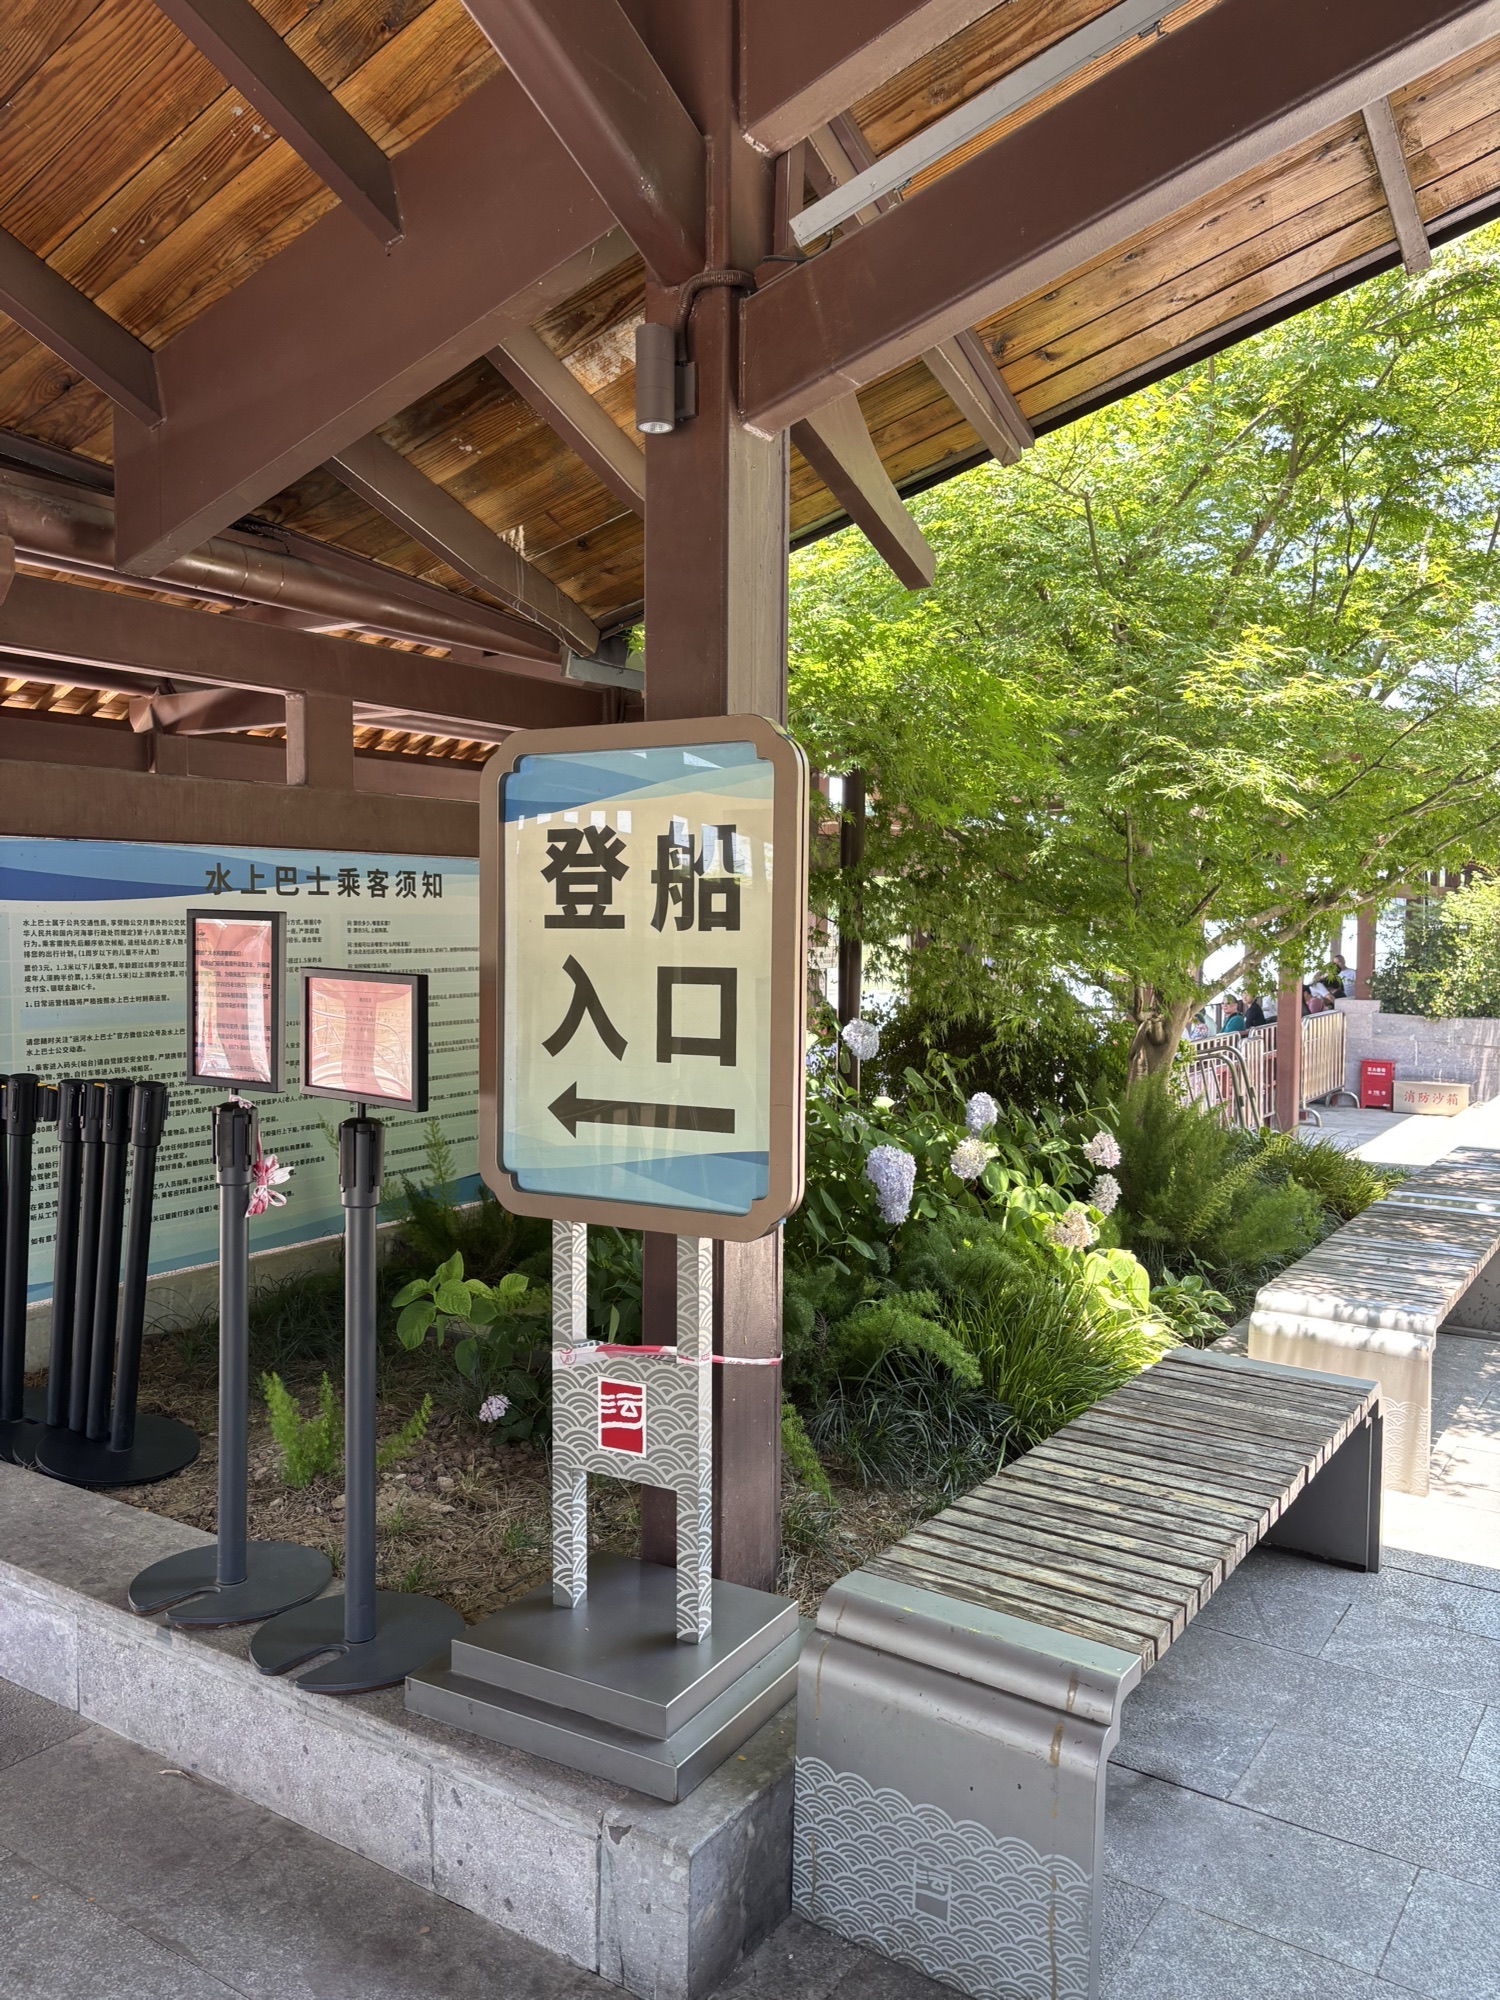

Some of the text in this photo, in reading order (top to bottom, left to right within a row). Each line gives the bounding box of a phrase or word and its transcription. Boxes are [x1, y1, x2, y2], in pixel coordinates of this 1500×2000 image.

[205, 863, 443, 899] 水上巴士乘客须知
[541, 823, 741, 932] 登船
[24, 962, 187, 972] 票价3元，1.3米以下儿童免票，年龄超过6周岁但不超过
[542, 954, 737, 1066] 入口
[1403, 1089, 1459, 1106] 消防沙箱
